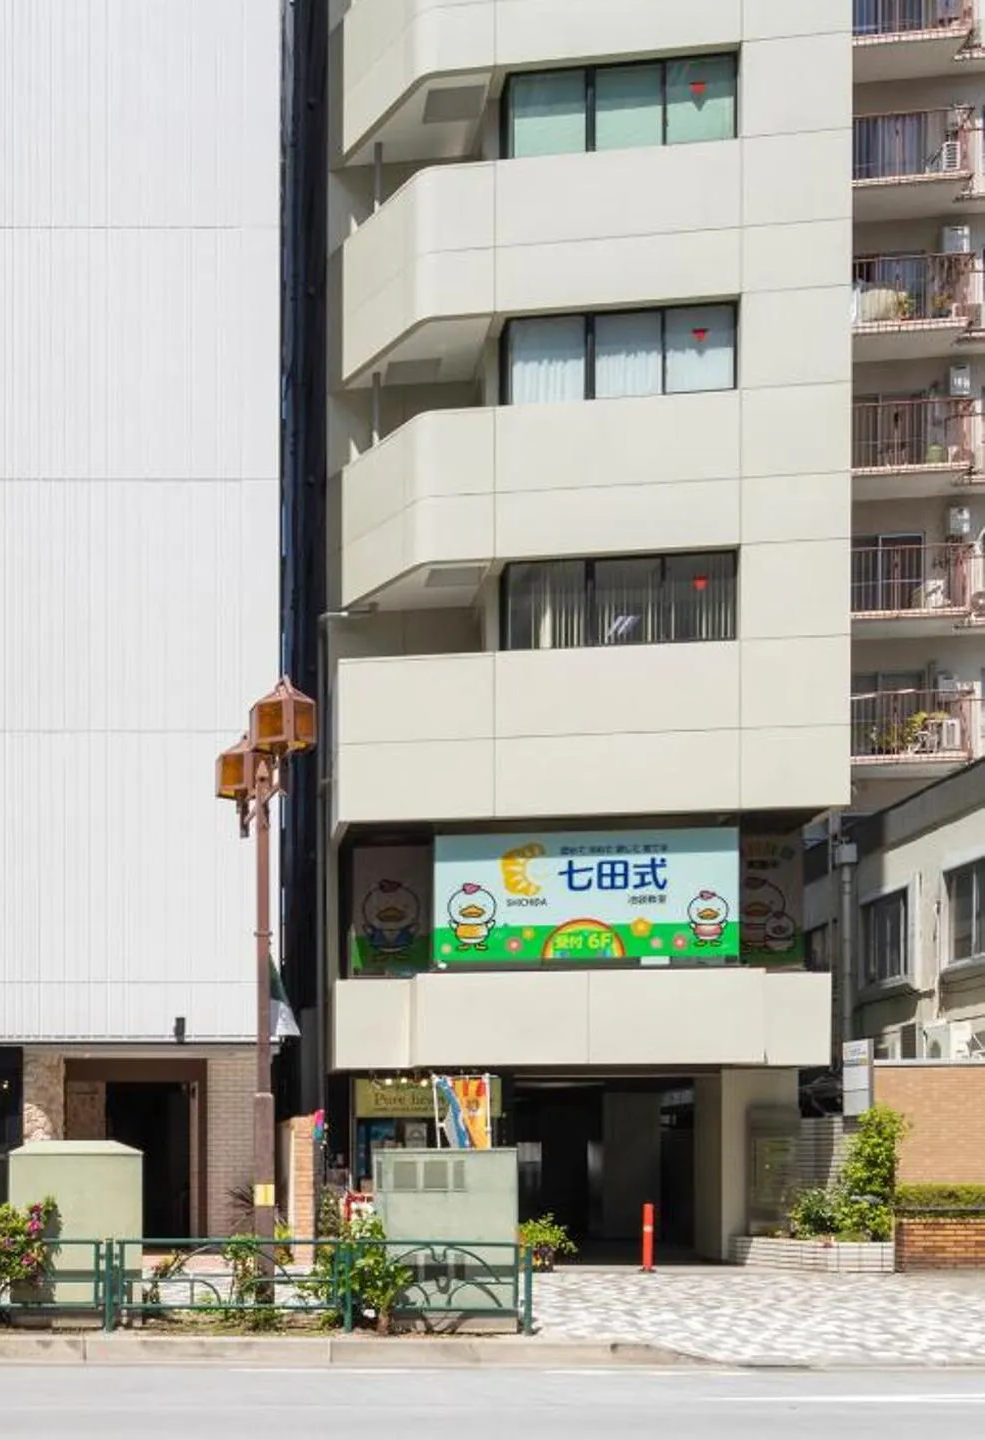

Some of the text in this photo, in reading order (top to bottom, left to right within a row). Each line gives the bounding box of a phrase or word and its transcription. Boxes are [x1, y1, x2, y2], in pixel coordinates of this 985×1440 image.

[558, 857, 668, 892] 七田式
[587, 931, 612, 949] 6F
